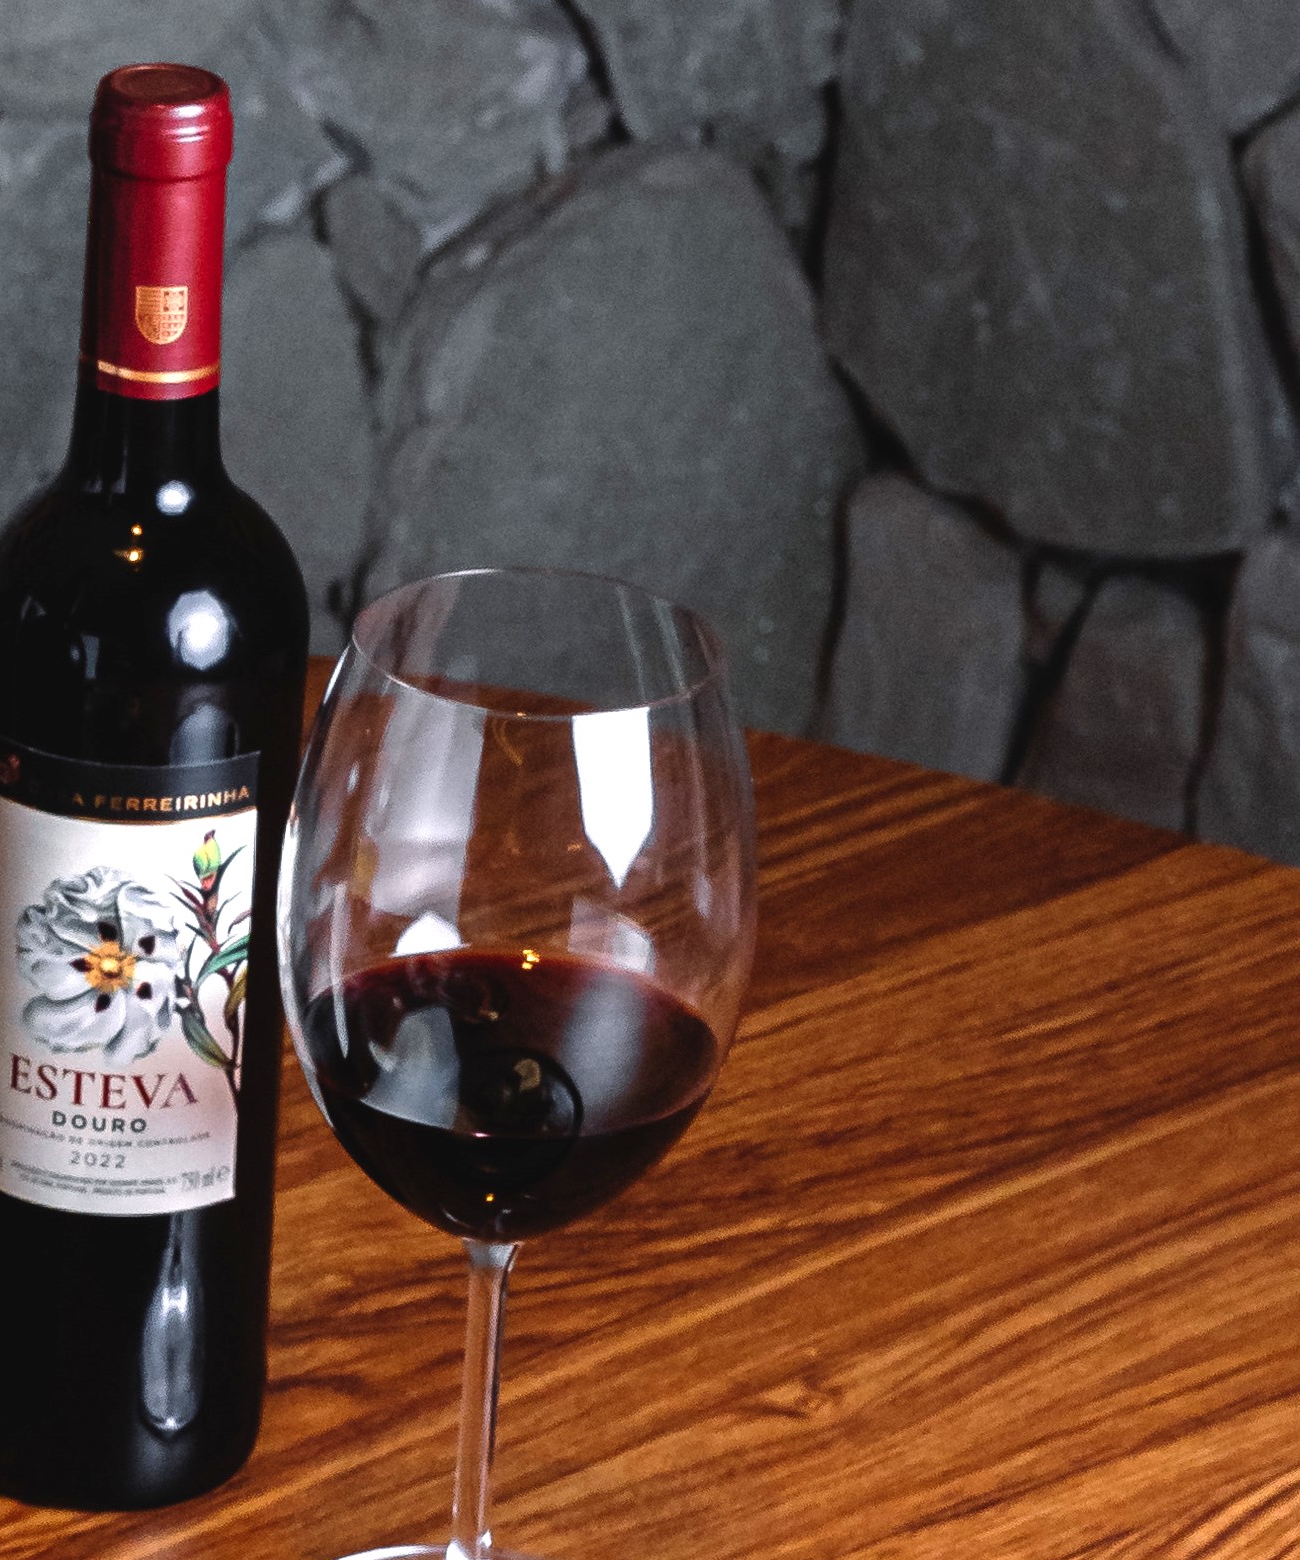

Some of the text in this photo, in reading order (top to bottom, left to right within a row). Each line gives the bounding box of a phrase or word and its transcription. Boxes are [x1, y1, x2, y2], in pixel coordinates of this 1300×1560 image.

[10, 1052, 198, 1110] ESTEVA
[52, 1110, 148, 1134] DOURO
[70, 1151, 126, 1169] 2022
